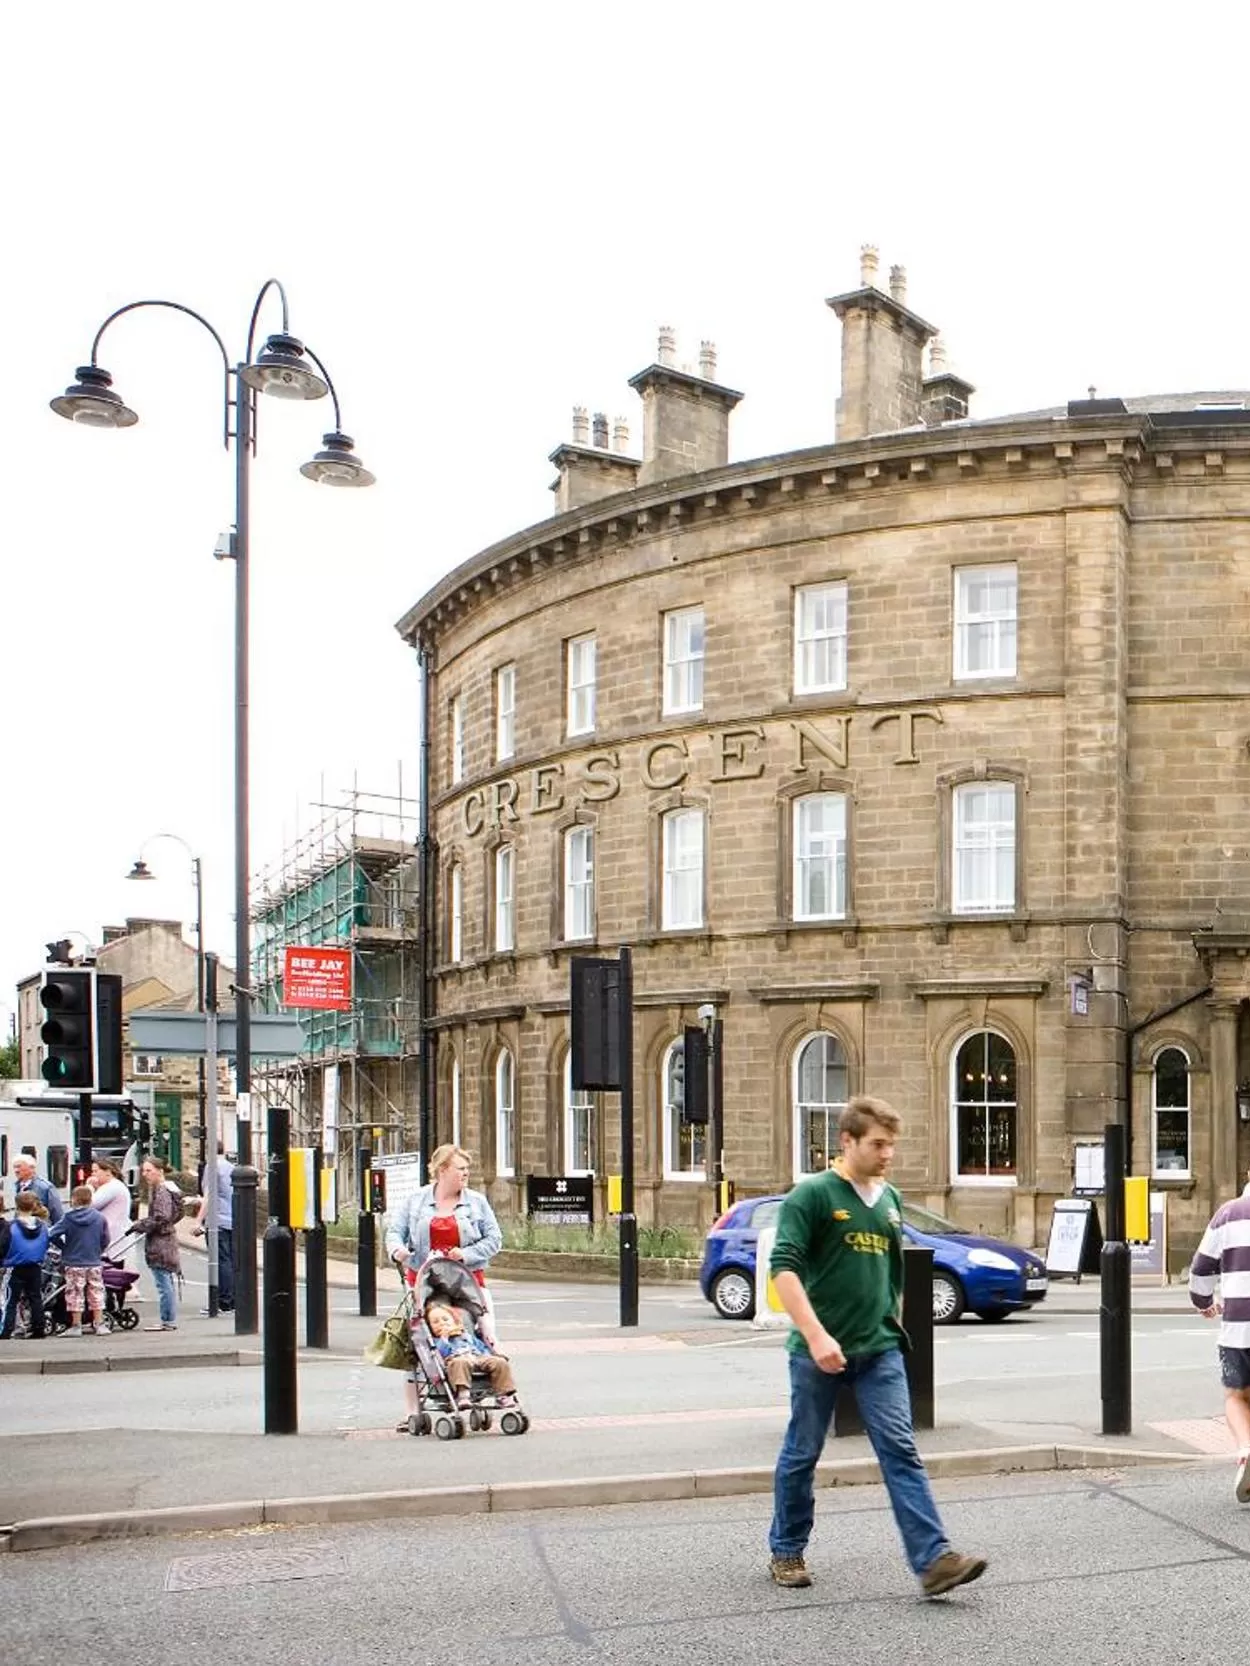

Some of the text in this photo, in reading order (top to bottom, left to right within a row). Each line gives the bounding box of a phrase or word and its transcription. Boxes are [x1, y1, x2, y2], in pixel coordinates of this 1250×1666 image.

[461, 708, 944, 838] CRESCENT
[291, 957, 345, 971] BEE JAY
